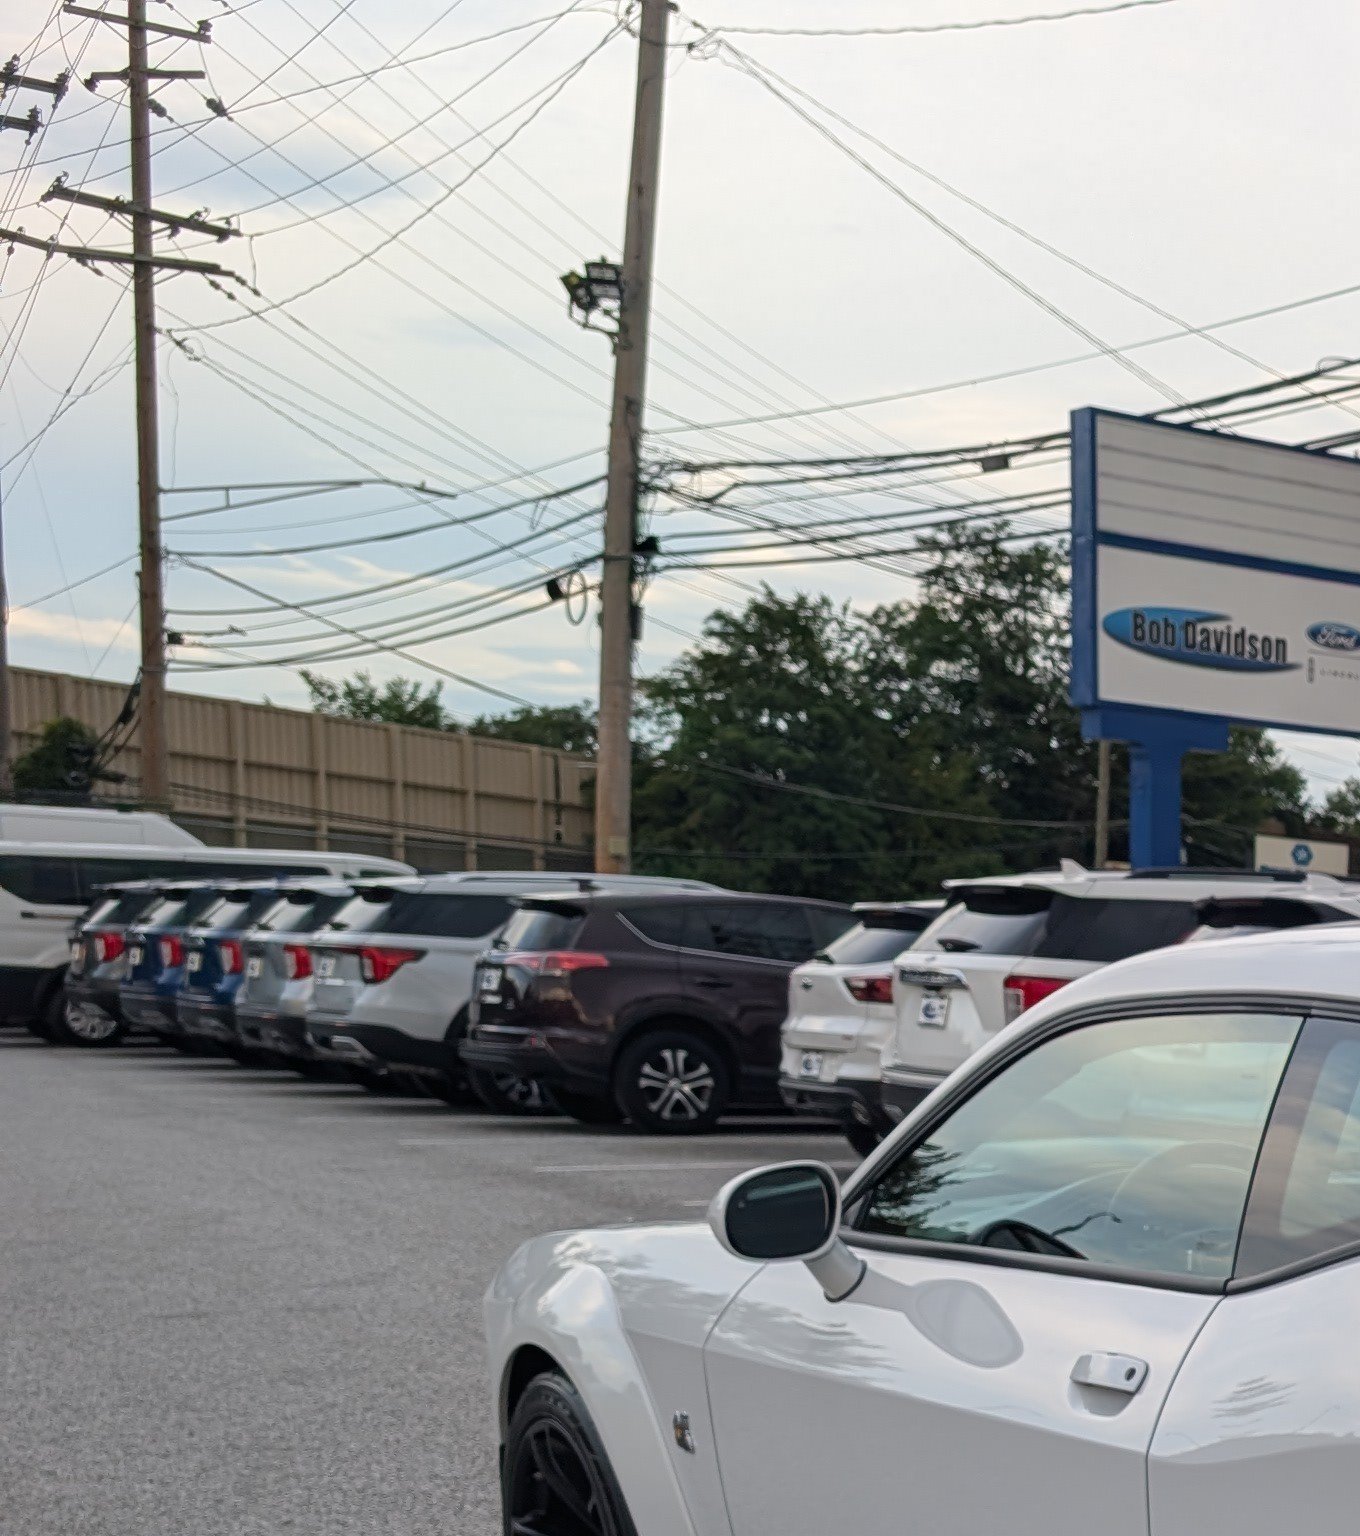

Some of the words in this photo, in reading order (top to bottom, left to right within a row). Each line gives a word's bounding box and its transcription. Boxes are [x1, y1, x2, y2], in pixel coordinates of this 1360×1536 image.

[1132, 611, 1176, 647] Bob
[1184, 620, 1288, 663] Davidson
[1316, 624, 1358, 648] Ford
